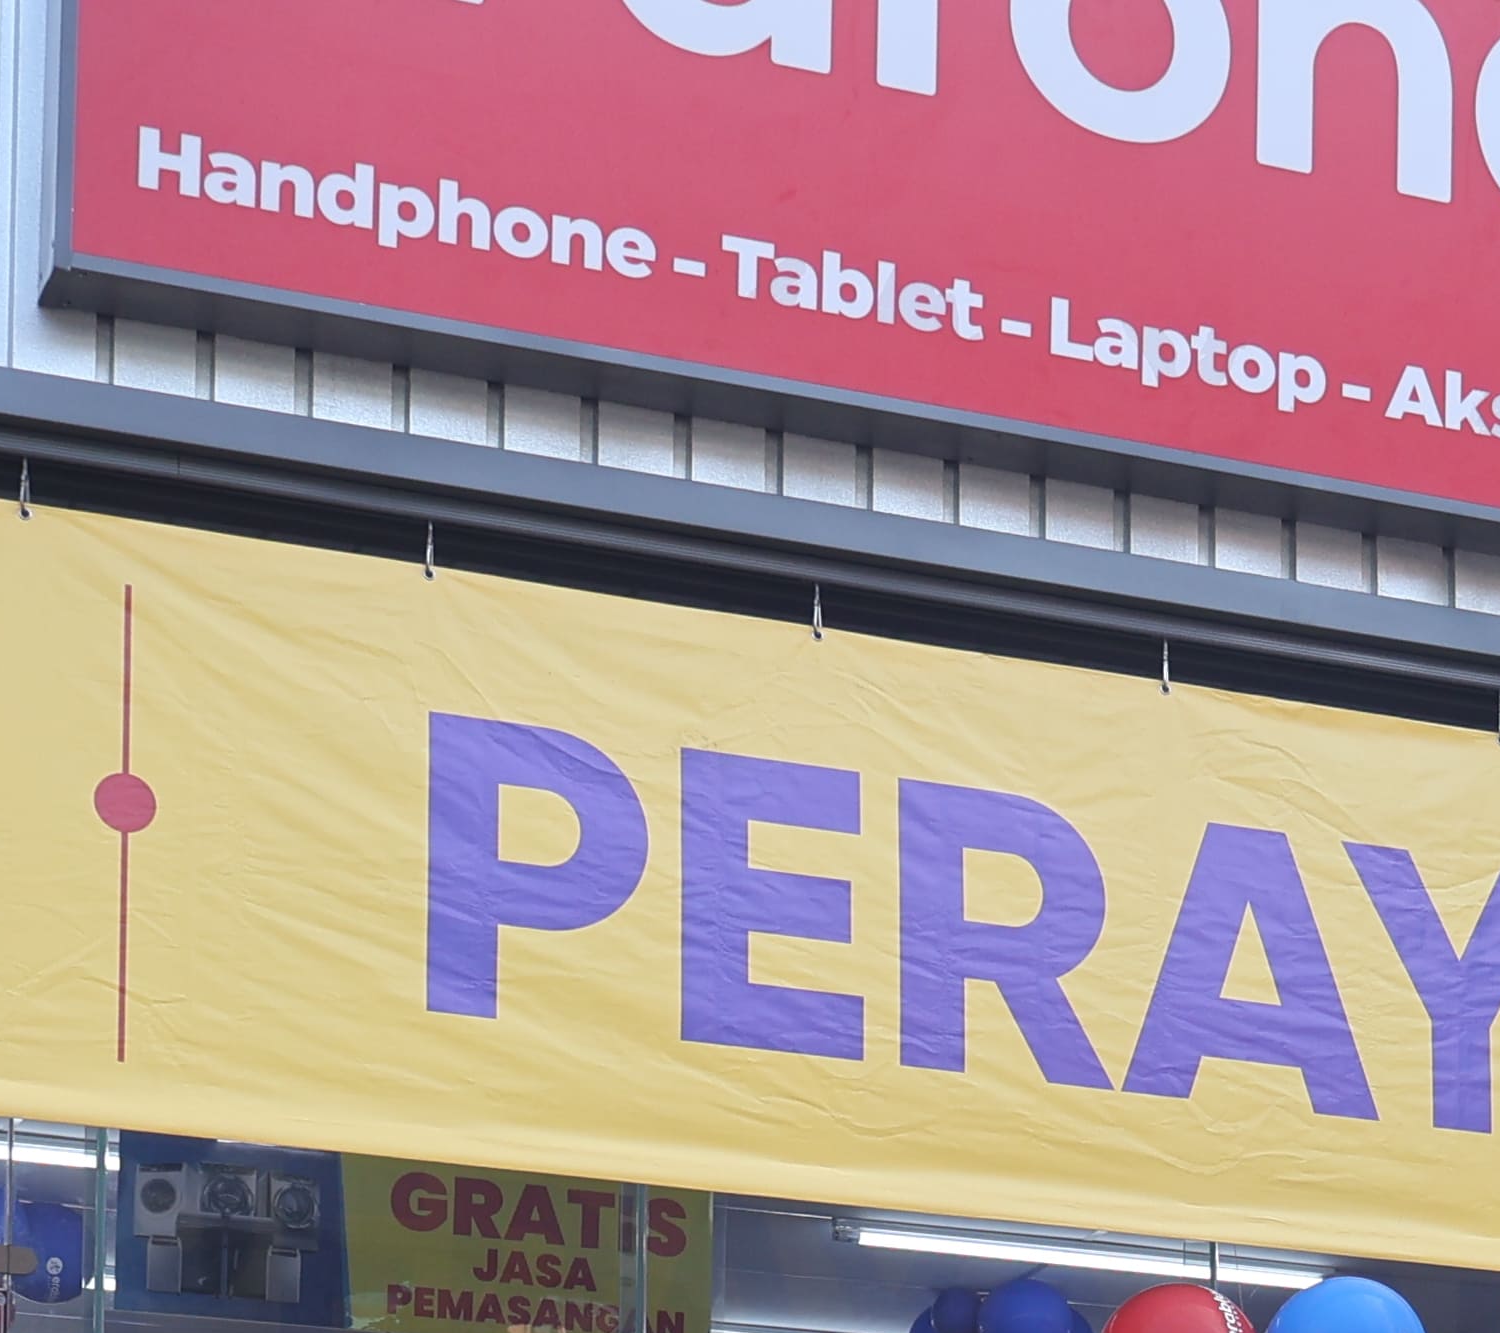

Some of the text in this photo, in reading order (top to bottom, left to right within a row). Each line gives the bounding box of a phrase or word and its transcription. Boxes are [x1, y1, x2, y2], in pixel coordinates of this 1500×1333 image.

[138, 126, 656, 279] Handphone
[722, 235, 984, 341] Tablet
[1051, 297, 1327, 411] Laptop
[390, 1171, 687, 1258] GRATIS
[473, 1249, 597, 1292] JASA
